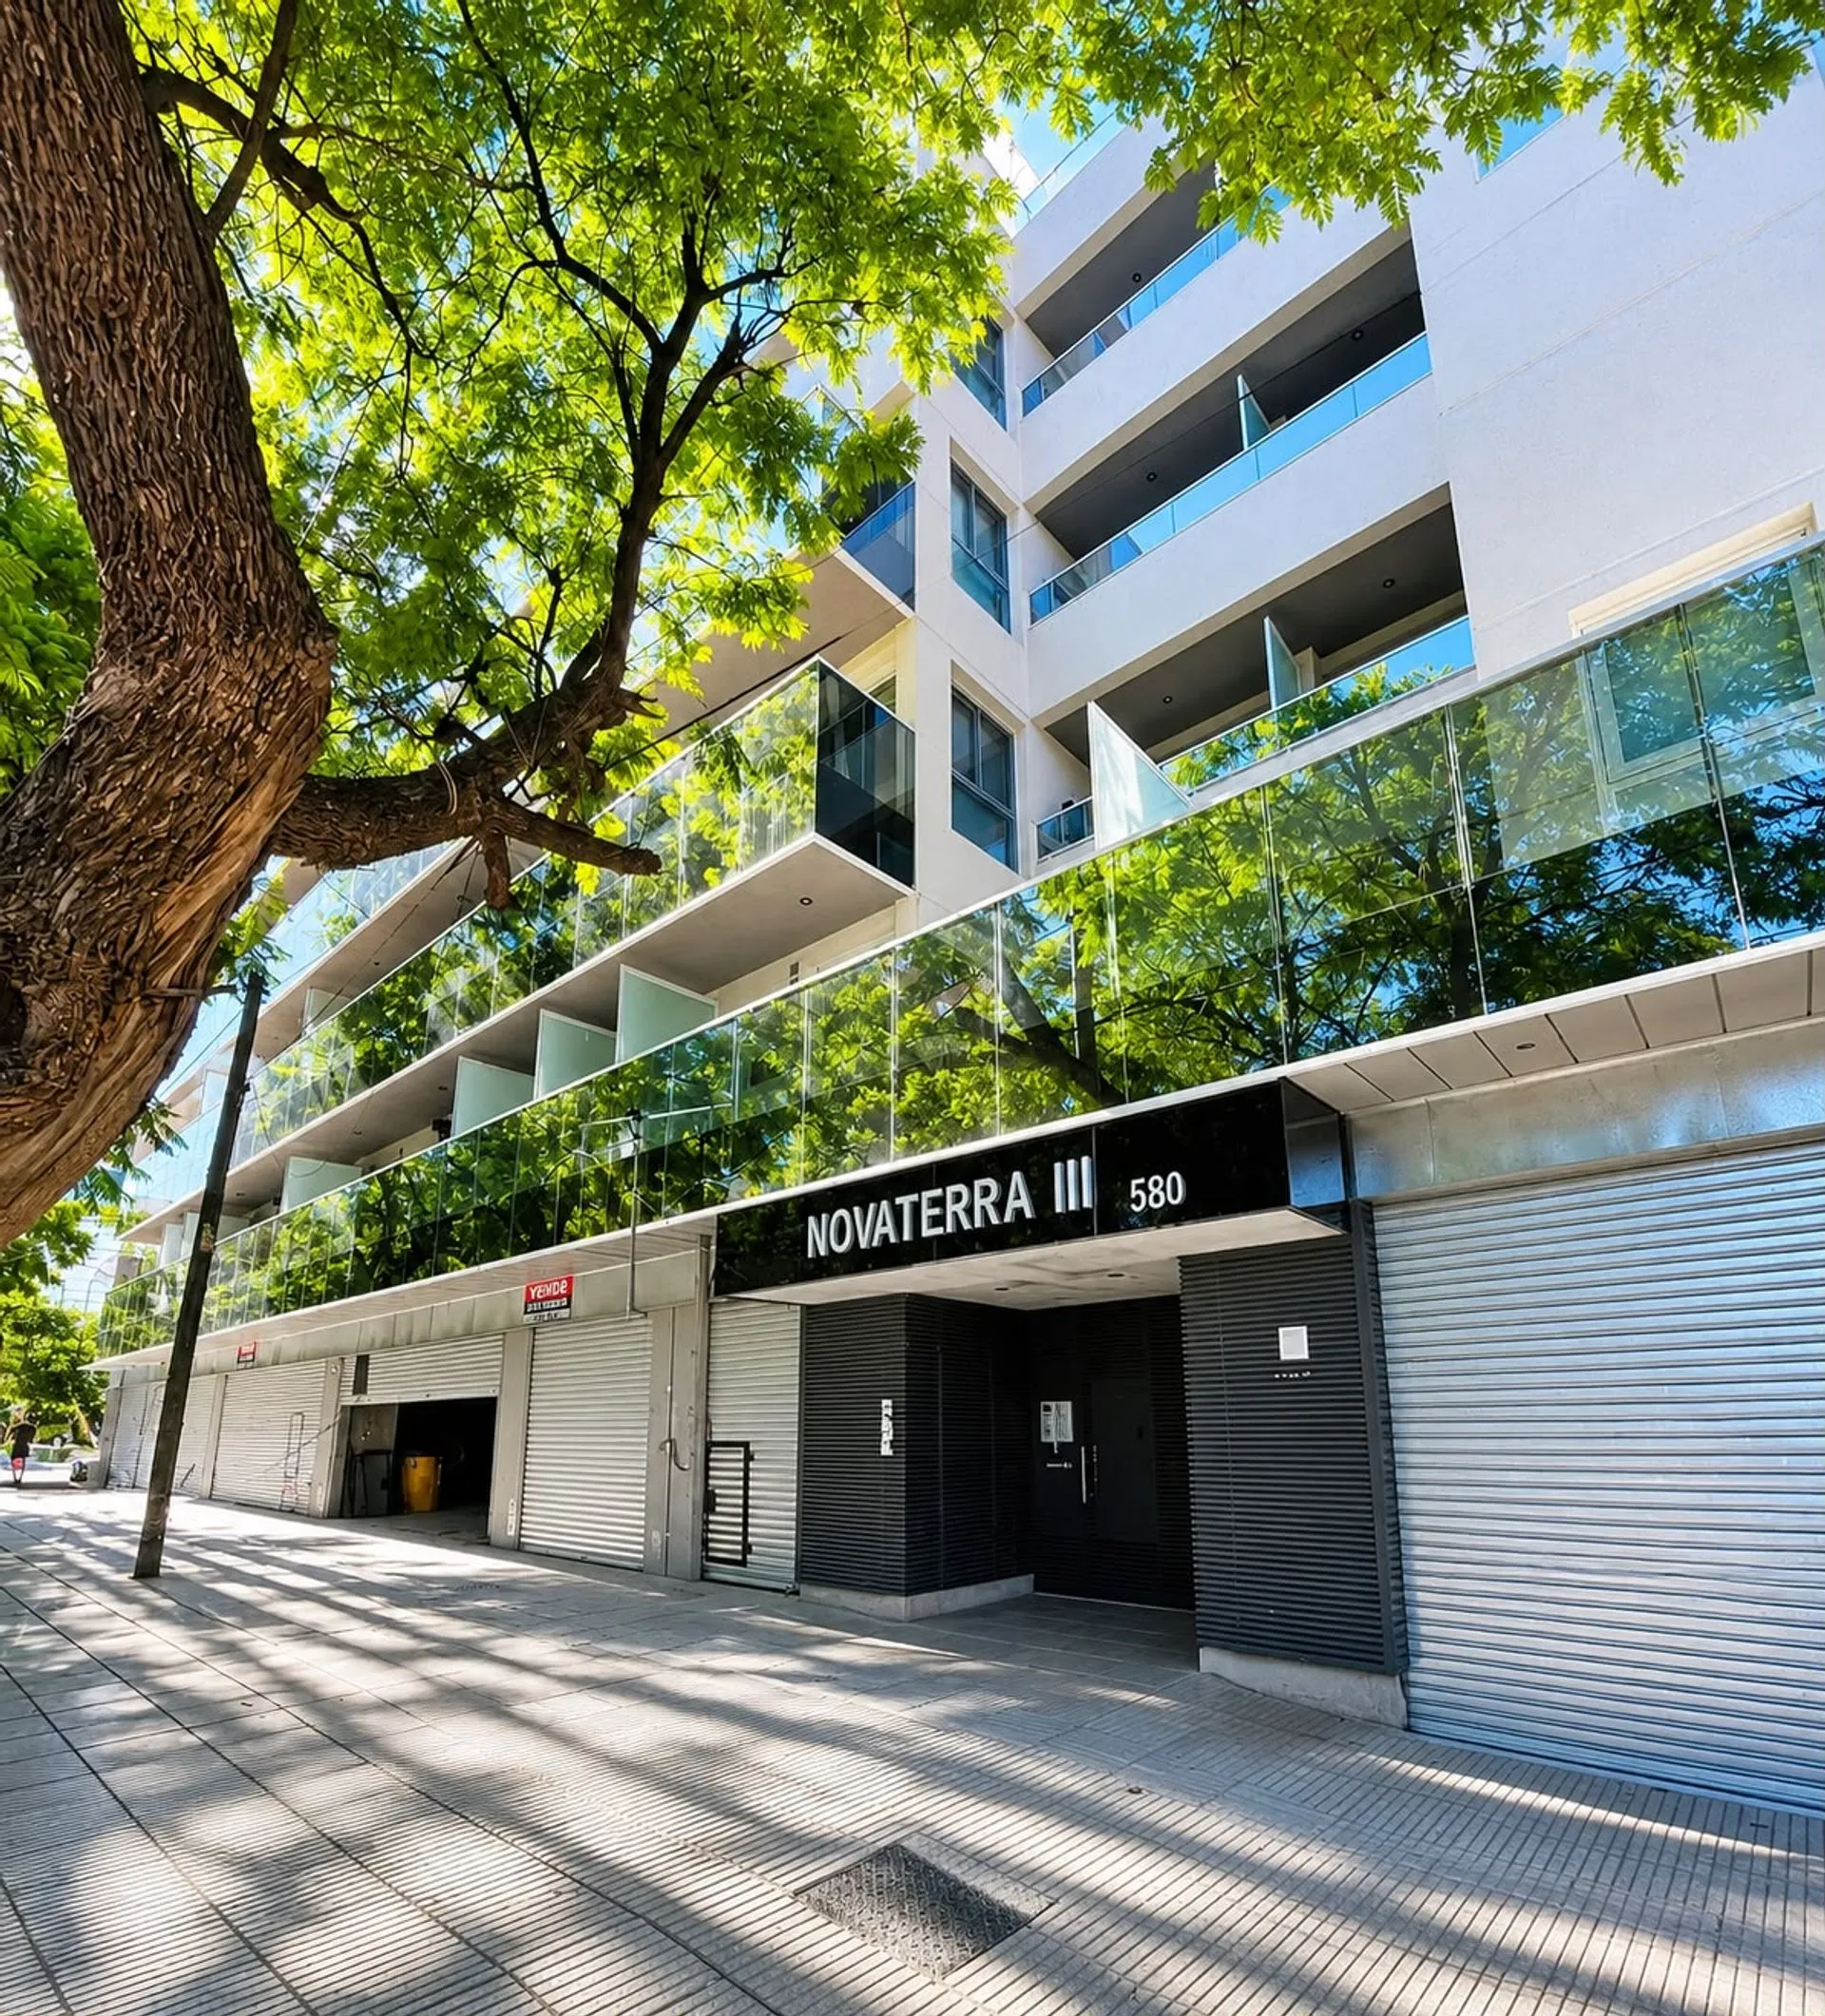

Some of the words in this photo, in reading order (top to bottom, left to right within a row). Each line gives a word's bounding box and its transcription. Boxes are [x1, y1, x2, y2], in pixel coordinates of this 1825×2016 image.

[807, 1170, 1037, 1259] NOVATERRA
[1053, 1155, 1093, 1214] III
[1129, 1171, 1186, 1213] 580
